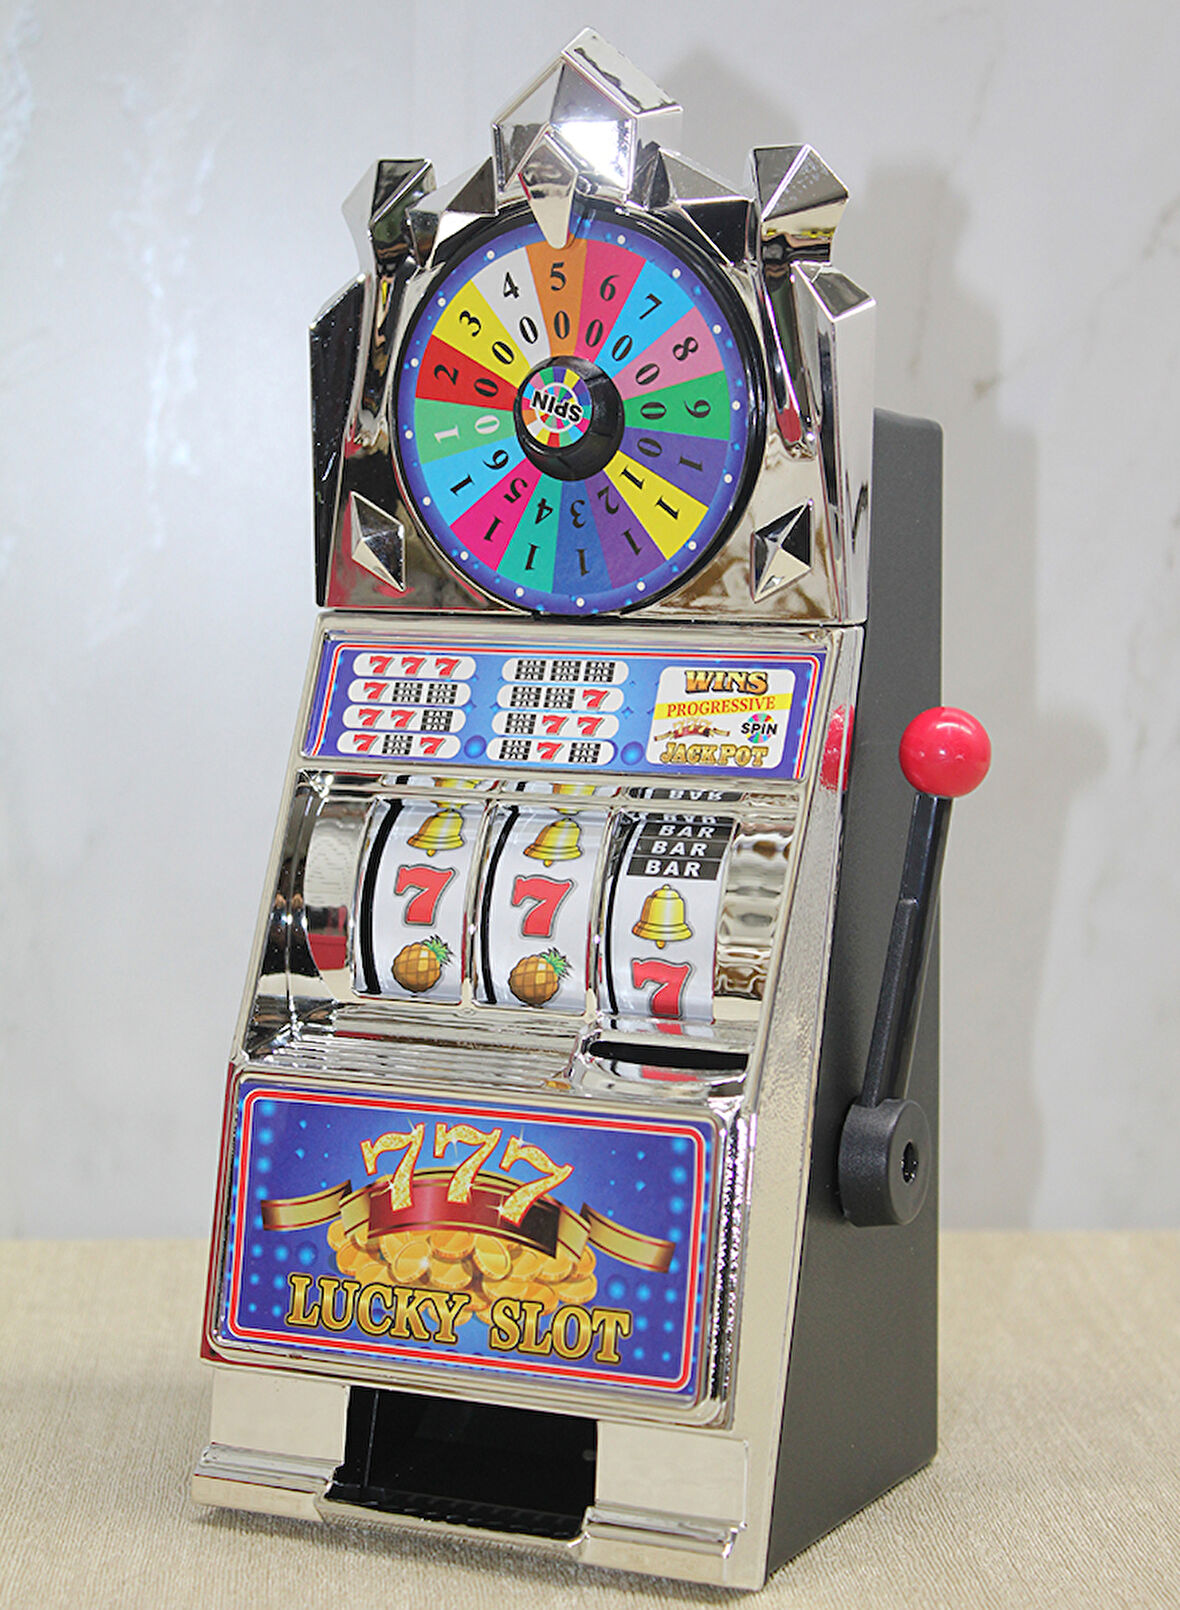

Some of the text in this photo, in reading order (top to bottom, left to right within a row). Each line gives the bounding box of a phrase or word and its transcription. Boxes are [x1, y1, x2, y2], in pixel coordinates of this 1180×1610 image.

[532, 391, 583, 422] SPIN
[684, 669, 769, 695] WINS
[667, 696, 776, 717] PROGRESSIVE
[740, 722, 778, 735] SPIN
[658, 824, 715, 838] BAR
[651, 841, 707, 856] BAR
[644, 859, 701, 877] BAR
[285, 1274, 633, 1364] LUCKY SLOT
